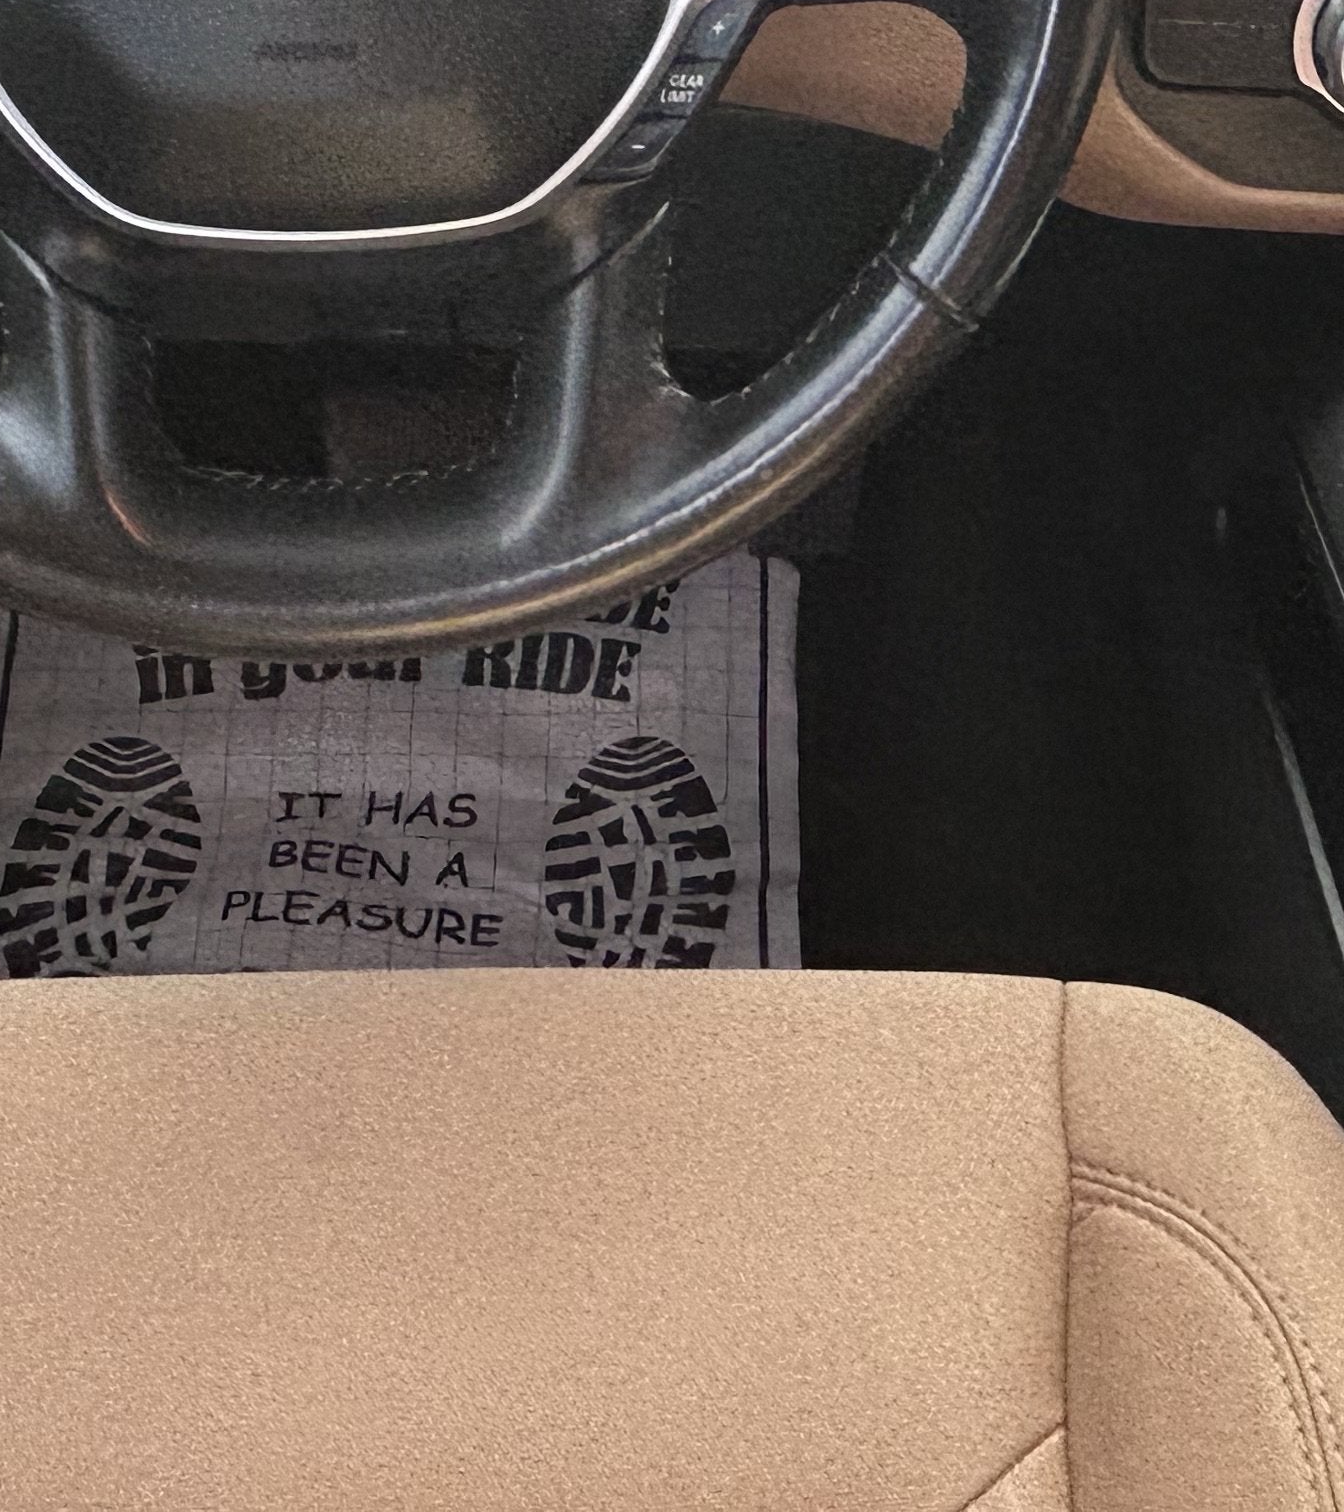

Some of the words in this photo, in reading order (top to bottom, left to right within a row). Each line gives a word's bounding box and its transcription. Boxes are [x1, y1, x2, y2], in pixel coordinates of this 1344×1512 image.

[132, 645, 215, 705] in
[462, 631, 642, 702] RIDE
[275, 791, 342, 823] IT
[365, 790, 478, 828] HAS
[268, 839, 410, 887] BEEN
[435, 851, 469, 889] A
[221, 889, 505, 947] PLEASURE
